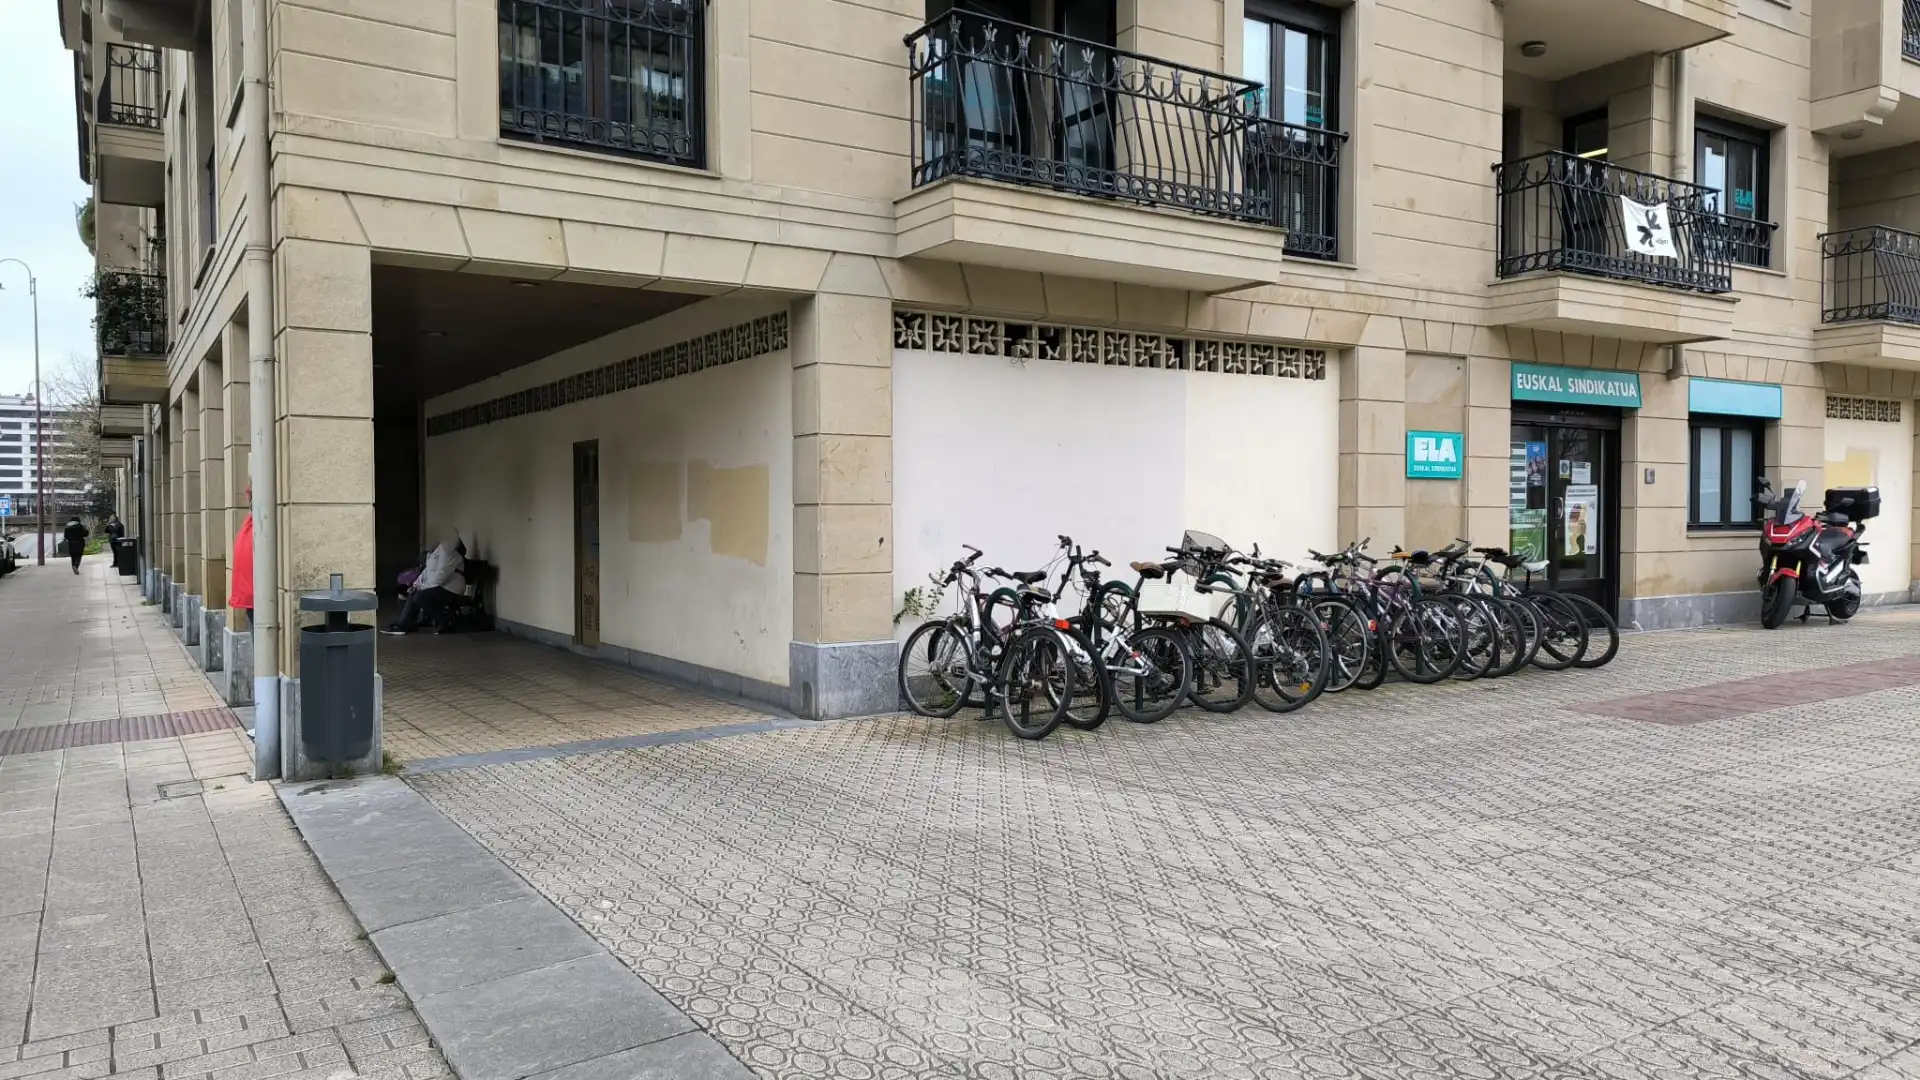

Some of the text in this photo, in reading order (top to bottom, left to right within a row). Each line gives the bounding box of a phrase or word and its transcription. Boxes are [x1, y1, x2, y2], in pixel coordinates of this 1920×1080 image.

[1516, 373, 1637, 397] EUSKAL SINDIKATUA
[1414, 437, 1457, 463] ELA
